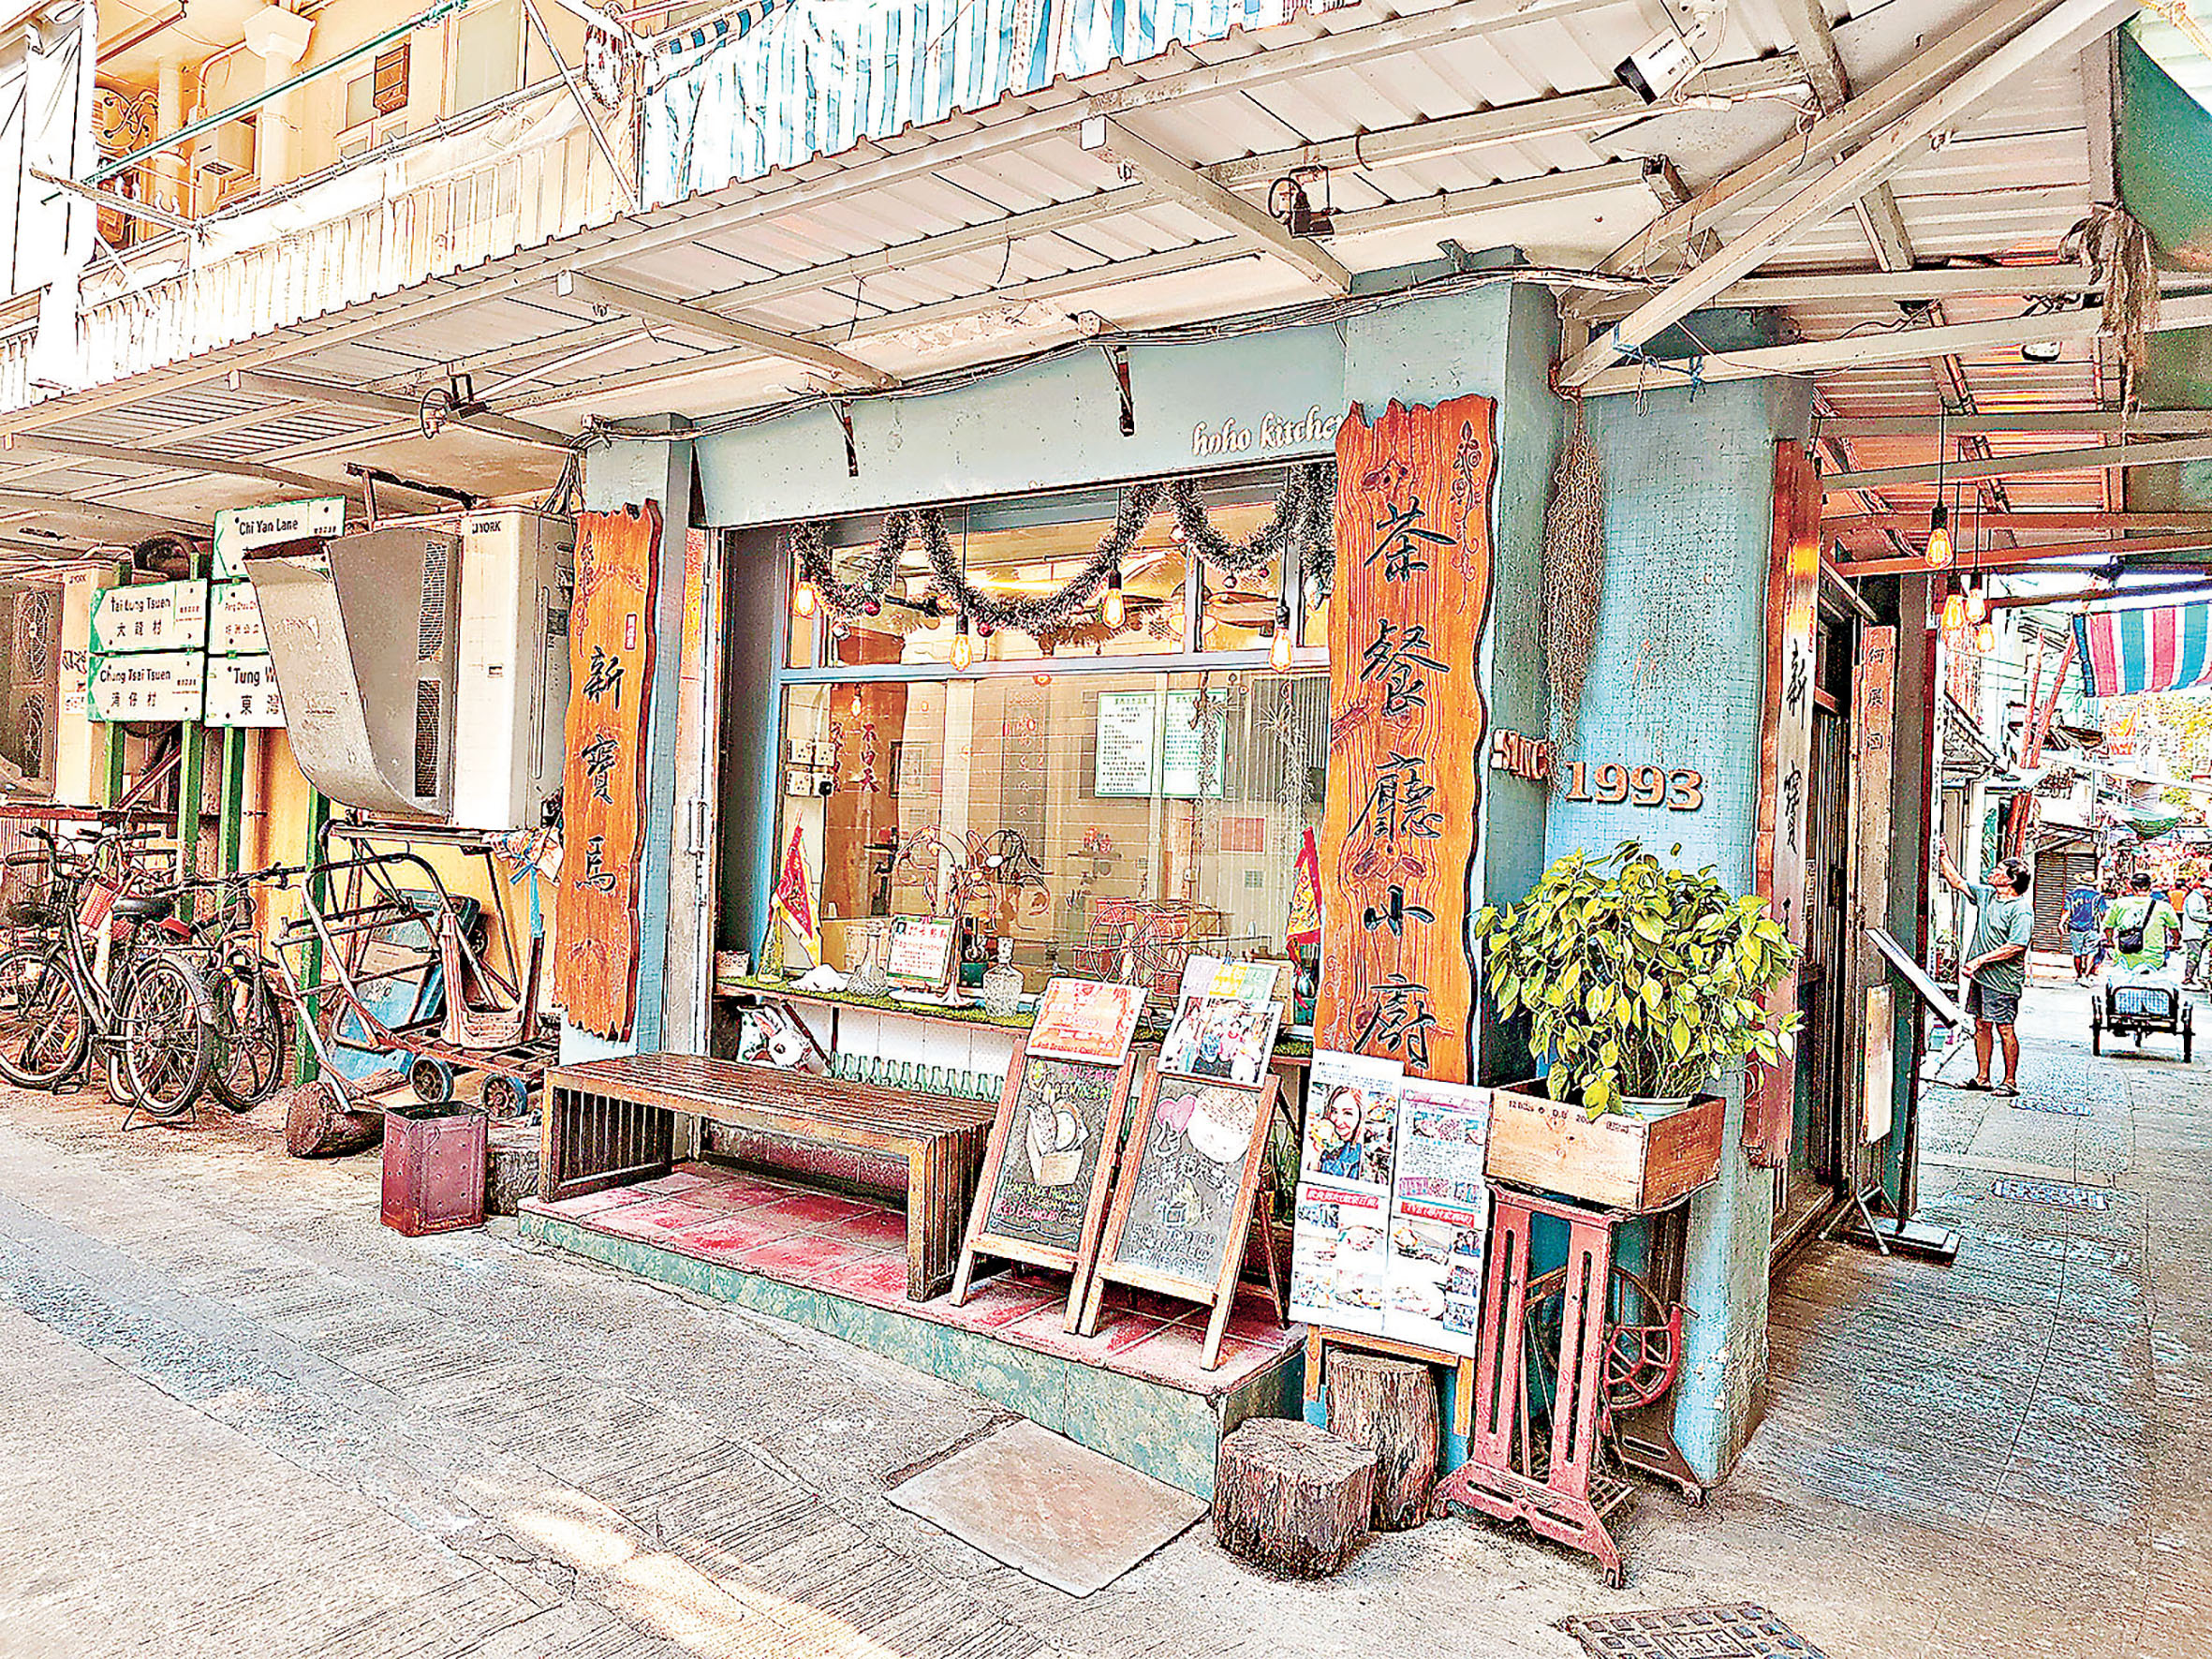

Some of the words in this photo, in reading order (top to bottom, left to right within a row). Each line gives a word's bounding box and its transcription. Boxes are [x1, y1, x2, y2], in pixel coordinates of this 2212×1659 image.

[1191, 417, 1252, 457] hoho
[239, 521, 255, 536] Chi
[256, 520, 274, 534] Yan
[276, 518, 299, 532] Lane
[146, 597, 171, 610] Tsuen
[146, 668, 171, 681] Tsuen
[233, 667, 260, 687] Tung
[574, 644, 626, 892] 新寶馬
[1347, 495, 1458, 1070] 茶餐廳小廚
[1565, 761, 1703, 813] 1993
